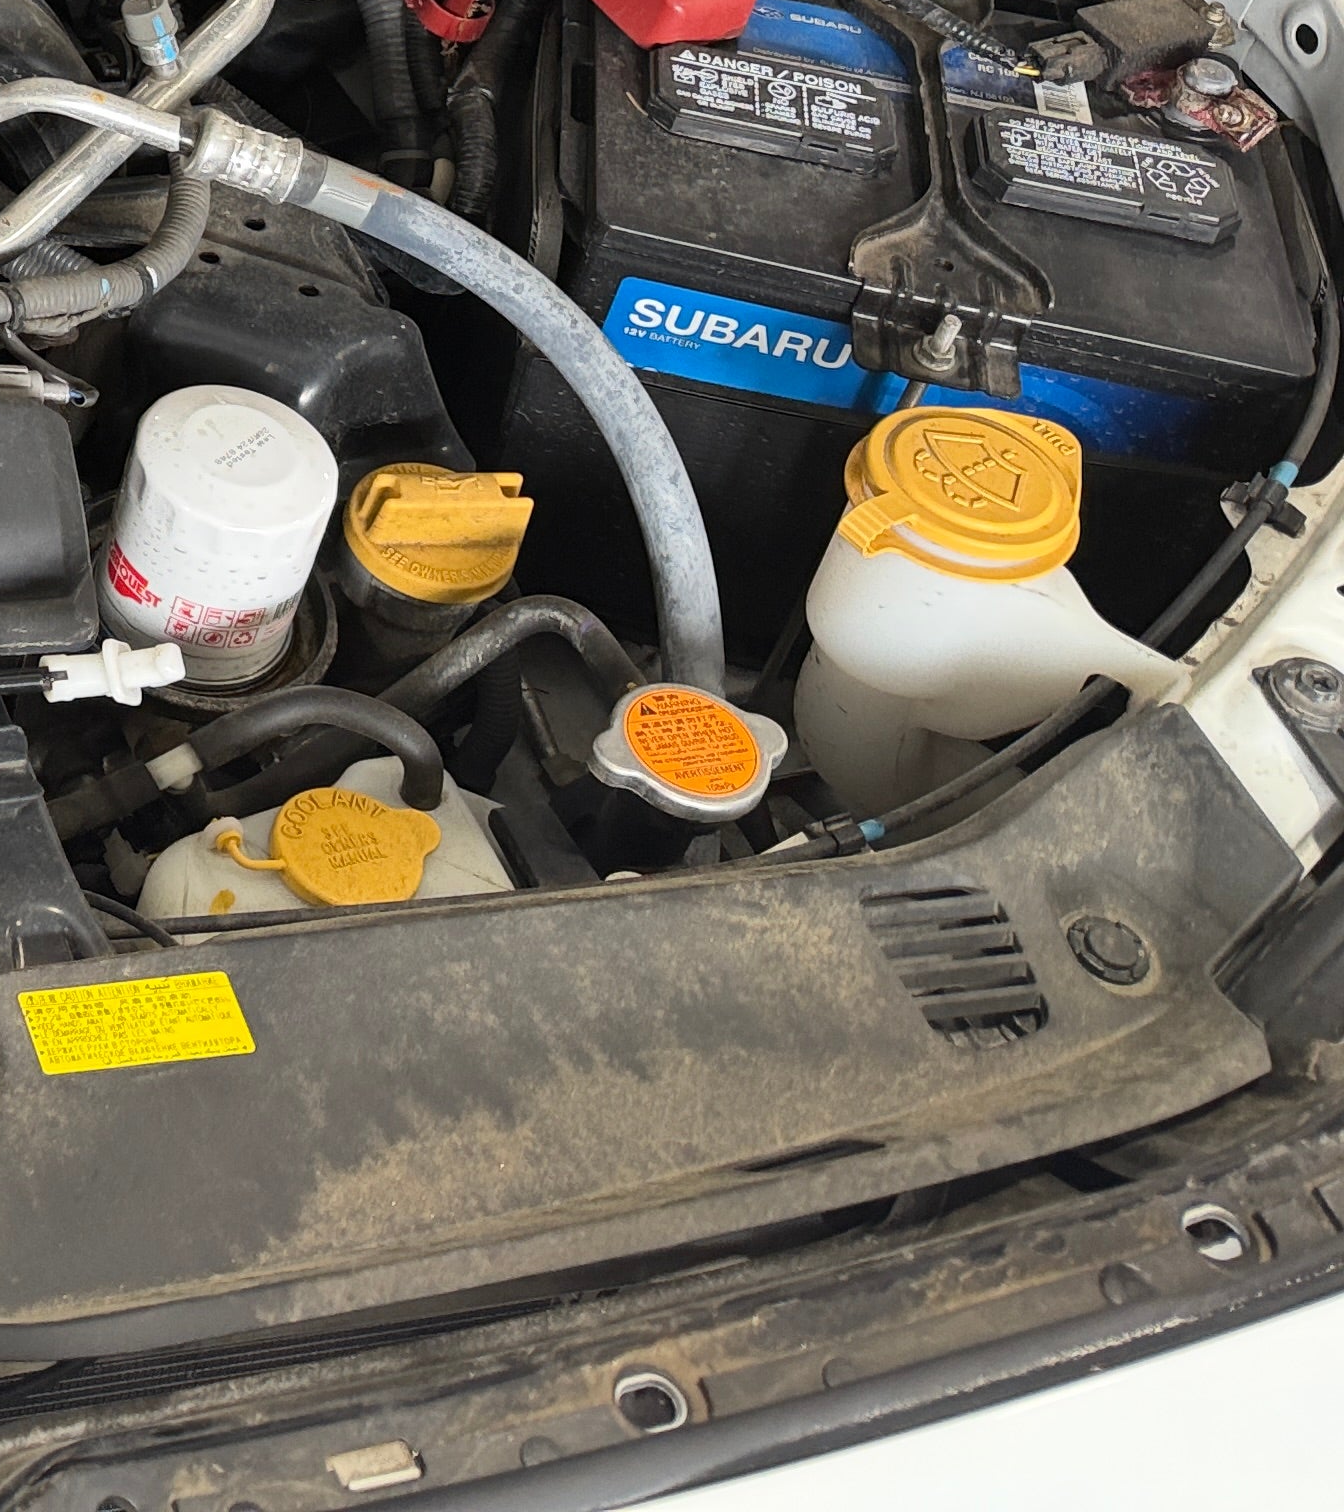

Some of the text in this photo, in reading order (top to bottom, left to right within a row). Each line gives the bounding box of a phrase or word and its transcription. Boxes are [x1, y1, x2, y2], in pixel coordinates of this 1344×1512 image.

[789, 13, 862, 35] SUBARU
[698, 53, 773, 77] DANGER
[793, 71, 862, 95] POISON
[629, 298, 852, 369] SUBARU
[649, 332, 702, 350] BATTERY
[381, 547, 409, 569] SEE
[718, 724, 735, 734] HOT
[674, 762, 746, 780] AVERTISSEMENT
[280, 790, 387, 839] COOLANT
[327, 845, 388, 871] MANUAL
[59, 985, 140, 1002] CAUTION ATTENTION
